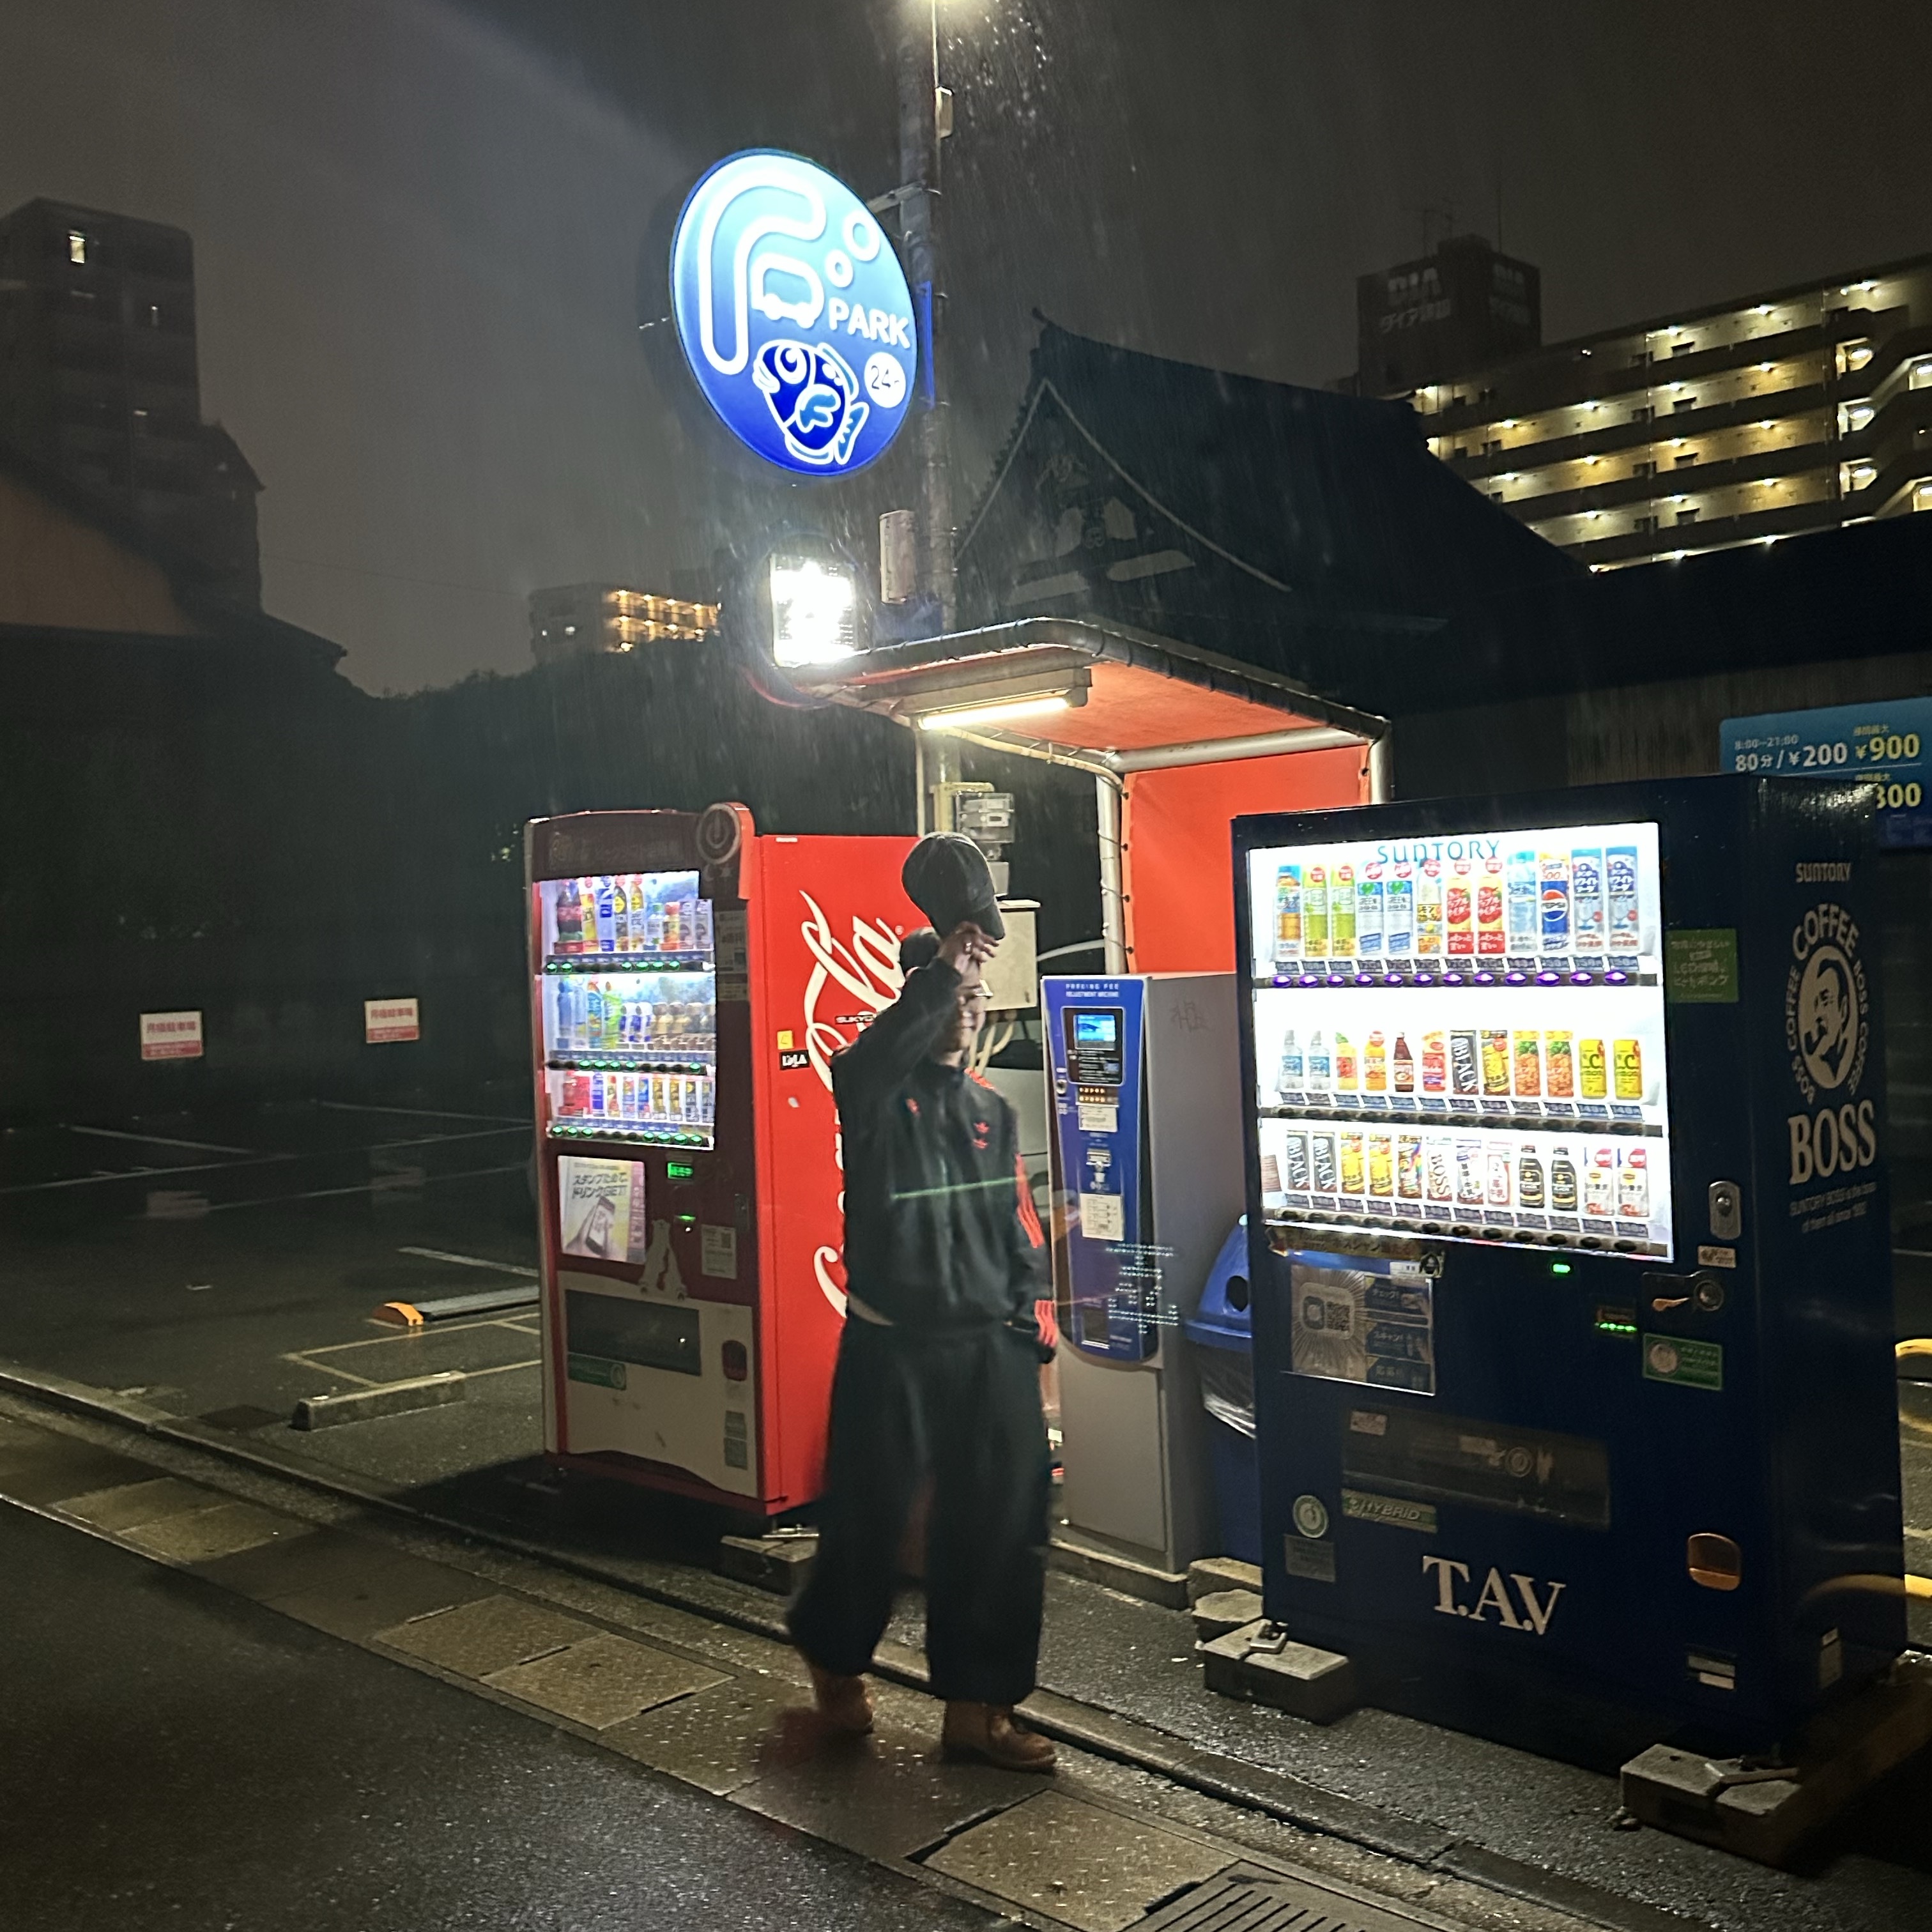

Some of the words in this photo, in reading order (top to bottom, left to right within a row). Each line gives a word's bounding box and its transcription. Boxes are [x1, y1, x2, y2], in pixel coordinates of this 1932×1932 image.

[829, 297, 910, 349] PARK
[871, 365, 900, 390] 24
[1377, 839, 1499, 864] SUNTORY
[1796, 862, 1851, 883] SUNTORY
[1792, 903, 1860, 960] COFFEE
[1785, 965, 1801, 1051] COFFEE
[1853, 958, 1869, 1015] BOSS
[1792, 1055, 1814, 1104] BOSS
[1788, 1099, 1877, 1185] BOSS
[1431, 1154, 1451, 1195] BOSS
